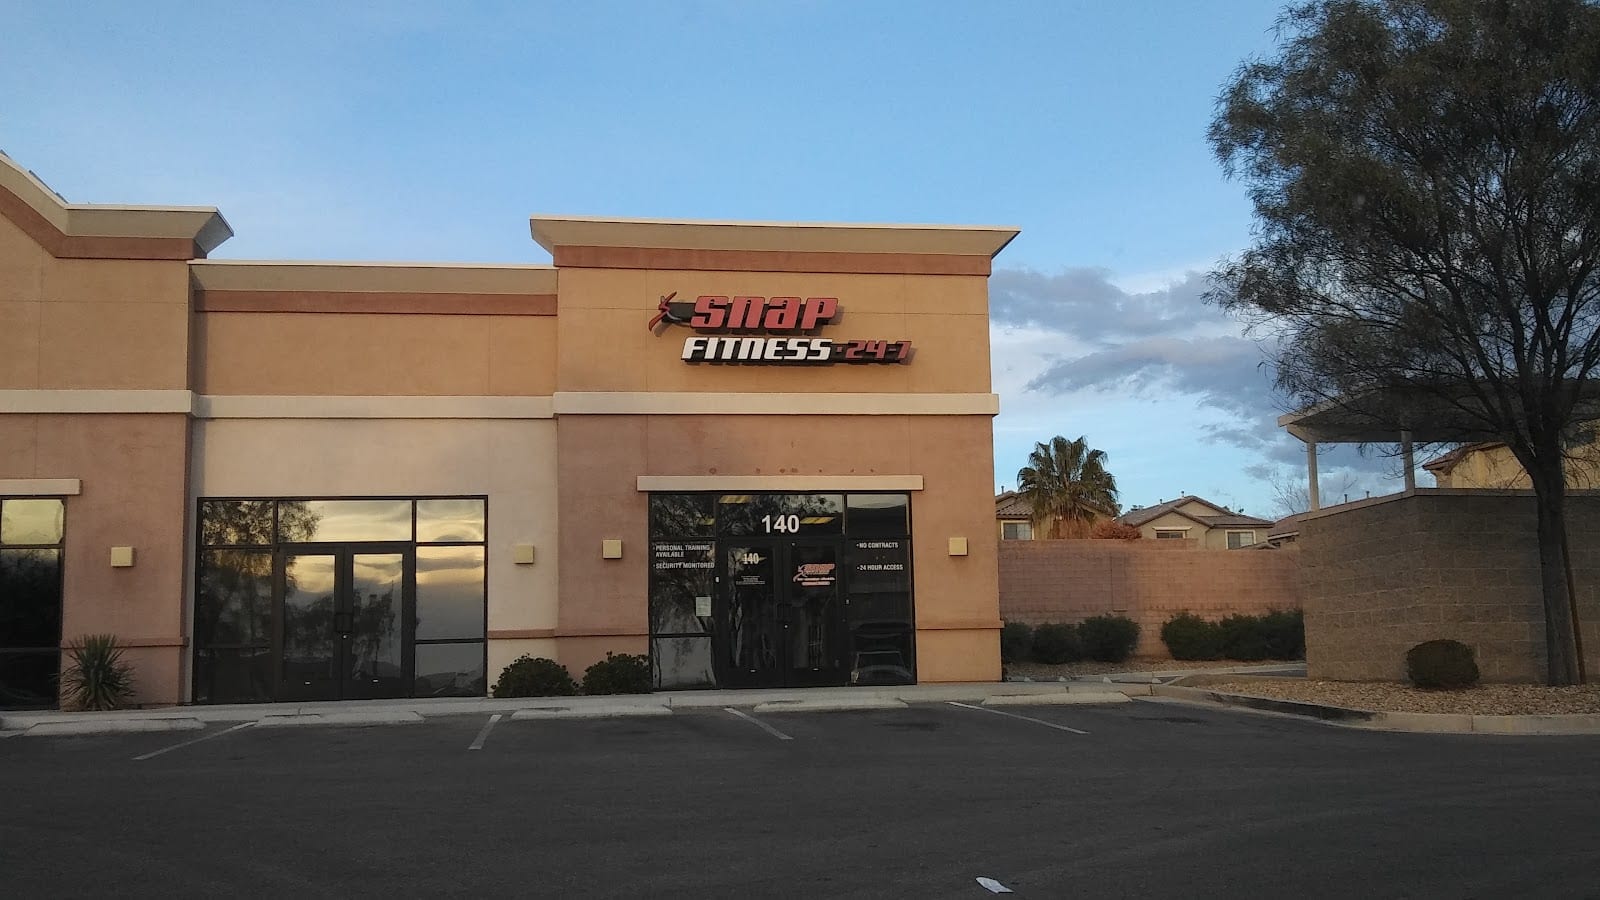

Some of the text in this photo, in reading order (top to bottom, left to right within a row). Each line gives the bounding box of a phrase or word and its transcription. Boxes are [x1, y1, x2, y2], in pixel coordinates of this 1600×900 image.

[681, 337, 833, 361] FITNESS
[761, 514, 800, 533] 140
[743, 553, 759, 565] 140
